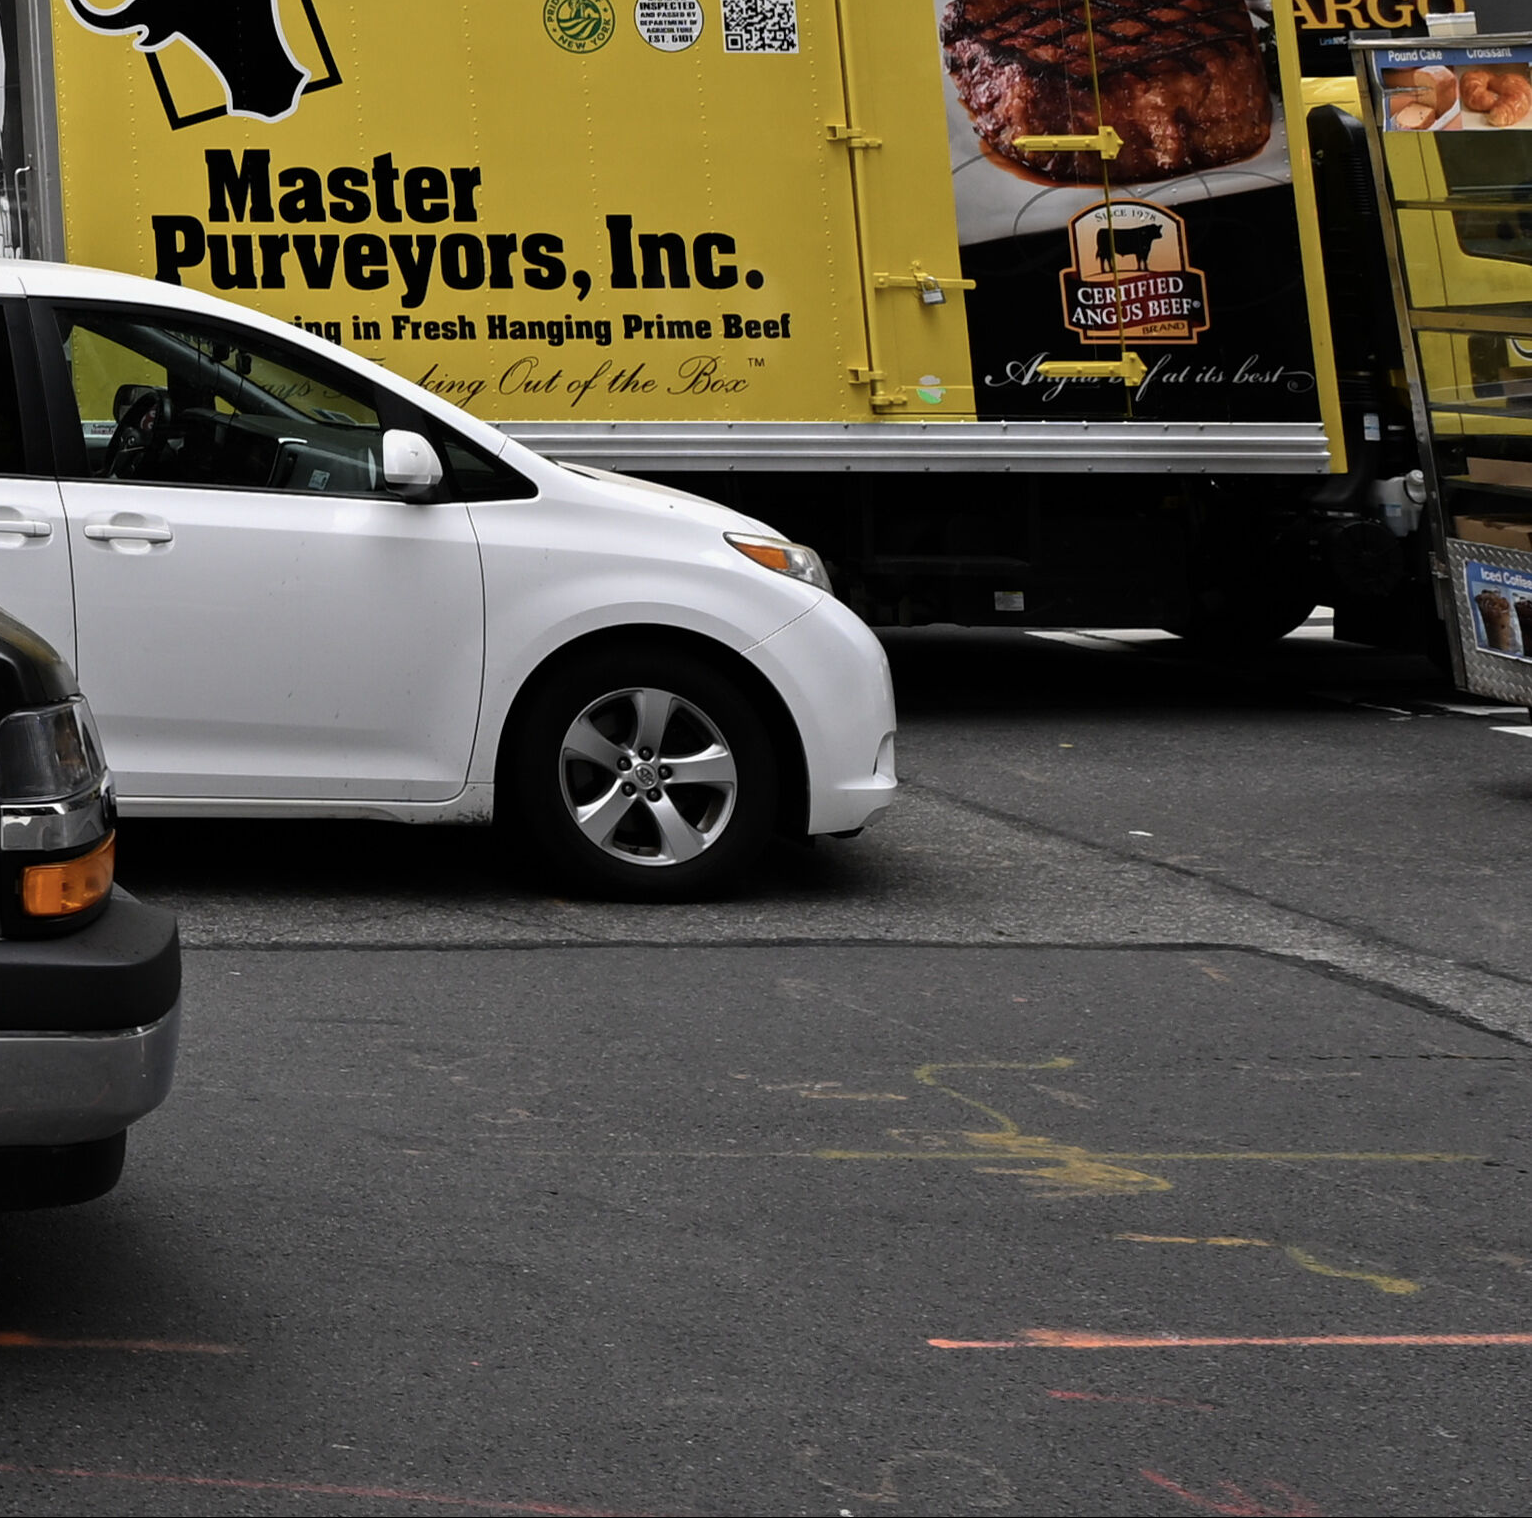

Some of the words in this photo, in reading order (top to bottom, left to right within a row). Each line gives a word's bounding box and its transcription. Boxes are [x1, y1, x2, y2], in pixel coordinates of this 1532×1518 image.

[639, 1, 696, 11] INSPECTED
[558, 34, 587, 50] NEW
[590, 18, 611, 46] YORK
[1388, 49, 1418, 62] Pound
[1419, 49, 1443, 61] Cake
[1466, 47, 1513, 59] Croissant
[204, 148, 483, 223] Master
[1094, 209, 1127, 223] SICE
[151, 214, 593, 309] Purveyors,
[604, 214, 765, 291] Inc.
[1077, 276, 1184, 305] CERTIFIED
[1071, 302, 1143, 325] ANGUS
[1147, 298, 1192, 318] BEEF
[352, 315, 381, 340] in
[391, 314, 477, 341] Fresh
[487, 313, 613, 347] Hanging
[623, 313, 712, 341] Prime
[723, 312, 792, 340] Beef
[1142, 321, 1186, 335] BRAND
[499, 356, 563, 395] Out
[567, 359, 612, 407] of
[607, 362, 658, 393] the
[1161, 365, 1191, 383] at
[1195, 365, 1225, 383] its
[1231, 354, 1302, 388] best
[1480, 567, 1503, 583] Iced
